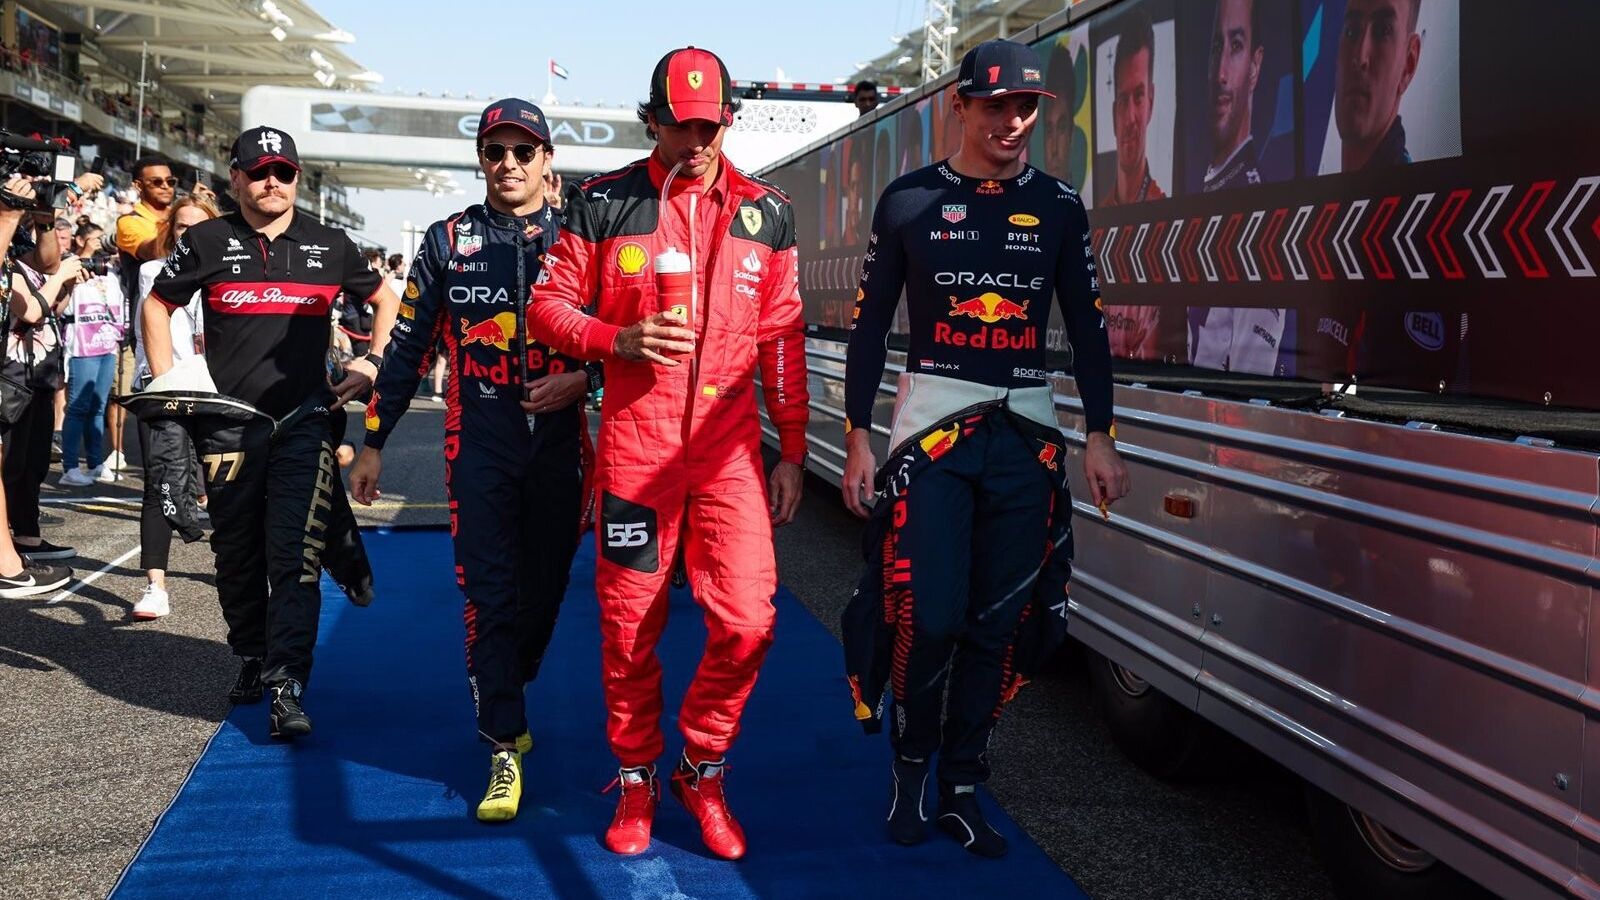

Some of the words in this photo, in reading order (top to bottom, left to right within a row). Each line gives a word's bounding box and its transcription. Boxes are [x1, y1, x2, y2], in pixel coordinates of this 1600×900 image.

[988, 66, 1000, 84] 1
[938, 165, 961, 186] zoom
[1017, 167, 1036, 187] zoom
[930, 231, 965, 240] Mobil
[1008, 232, 1040, 242] BYBIT
[448, 260, 475, 272] Mobil
[934, 272, 1045, 290] ORACLE
[221, 289, 259, 308] Alfa
[260, 287, 318, 305] Romeo
[935, 322, 987, 349] Red
[992, 327, 1036, 349] Bull
[1412, 313, 1440, 340] BELL
[203, 452, 245, 482] 77
[162, 482, 177, 517] Stake
[606, 522, 649, 548] 55
